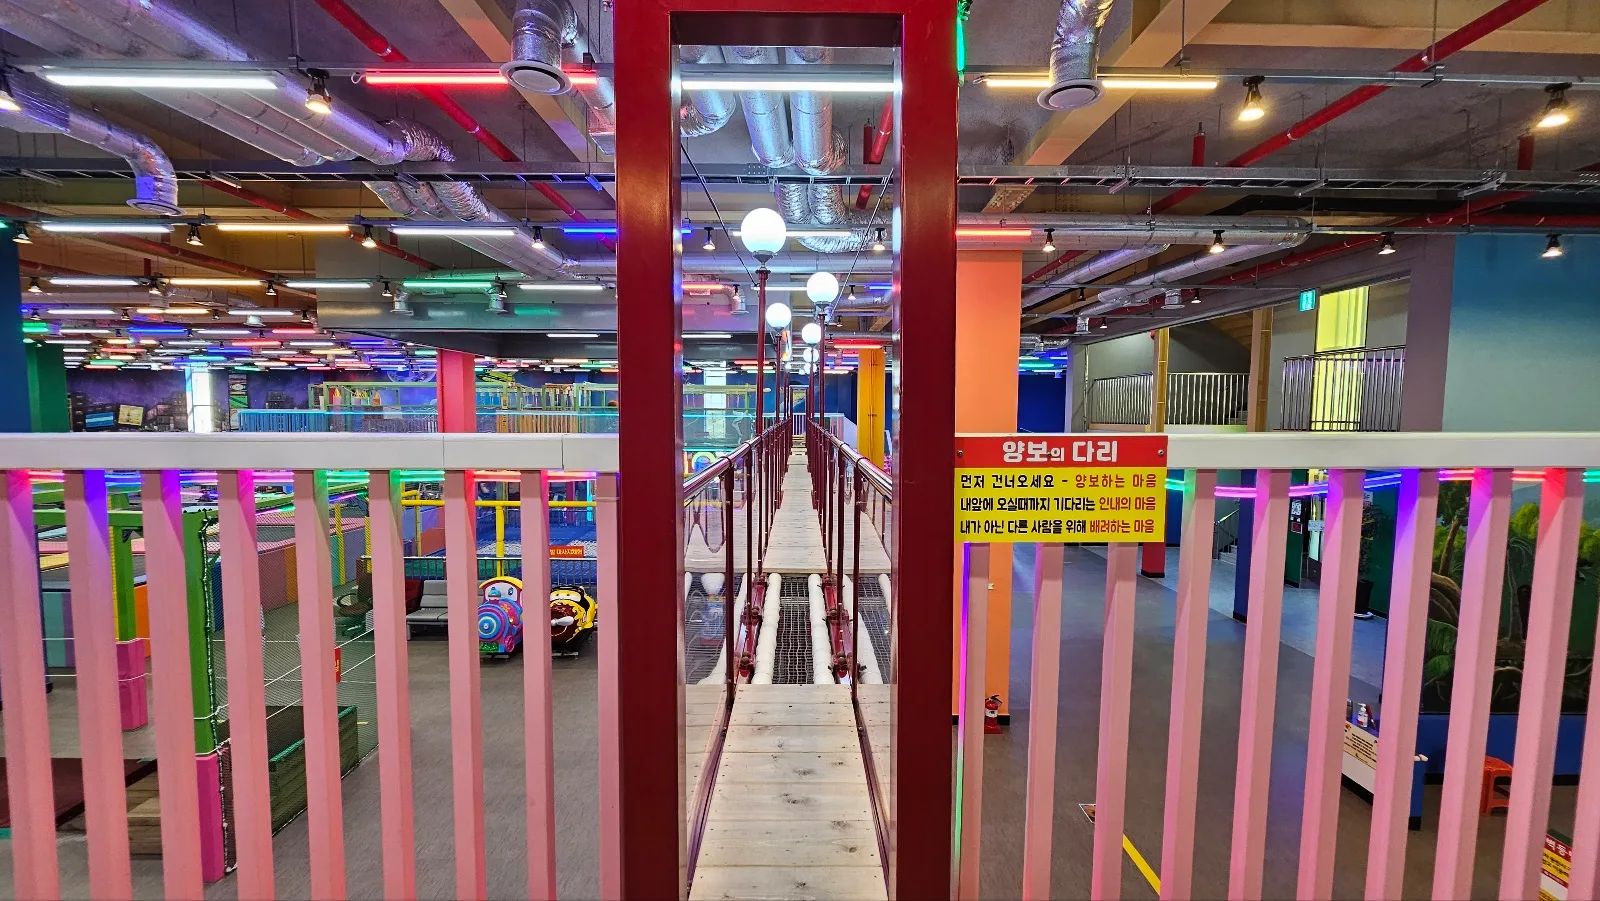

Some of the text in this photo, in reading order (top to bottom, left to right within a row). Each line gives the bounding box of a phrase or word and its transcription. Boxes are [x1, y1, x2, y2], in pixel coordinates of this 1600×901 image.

[1003, 440, 1118, 463] 양보의 다리
[960, 475, 985, 488] 먼저
[992, 475, 1054, 488] 건너오세요
[1075, 474, 1125, 488] 양보하는
[1132, 474, 1156, 488] 마음
[960, 497, 1156, 511] 내앞에 오실때까지 기다리는 인내의 마음
[960, 519, 1154, 534] 내가 아닌 다른 사람을 위해 배려하는 마음
